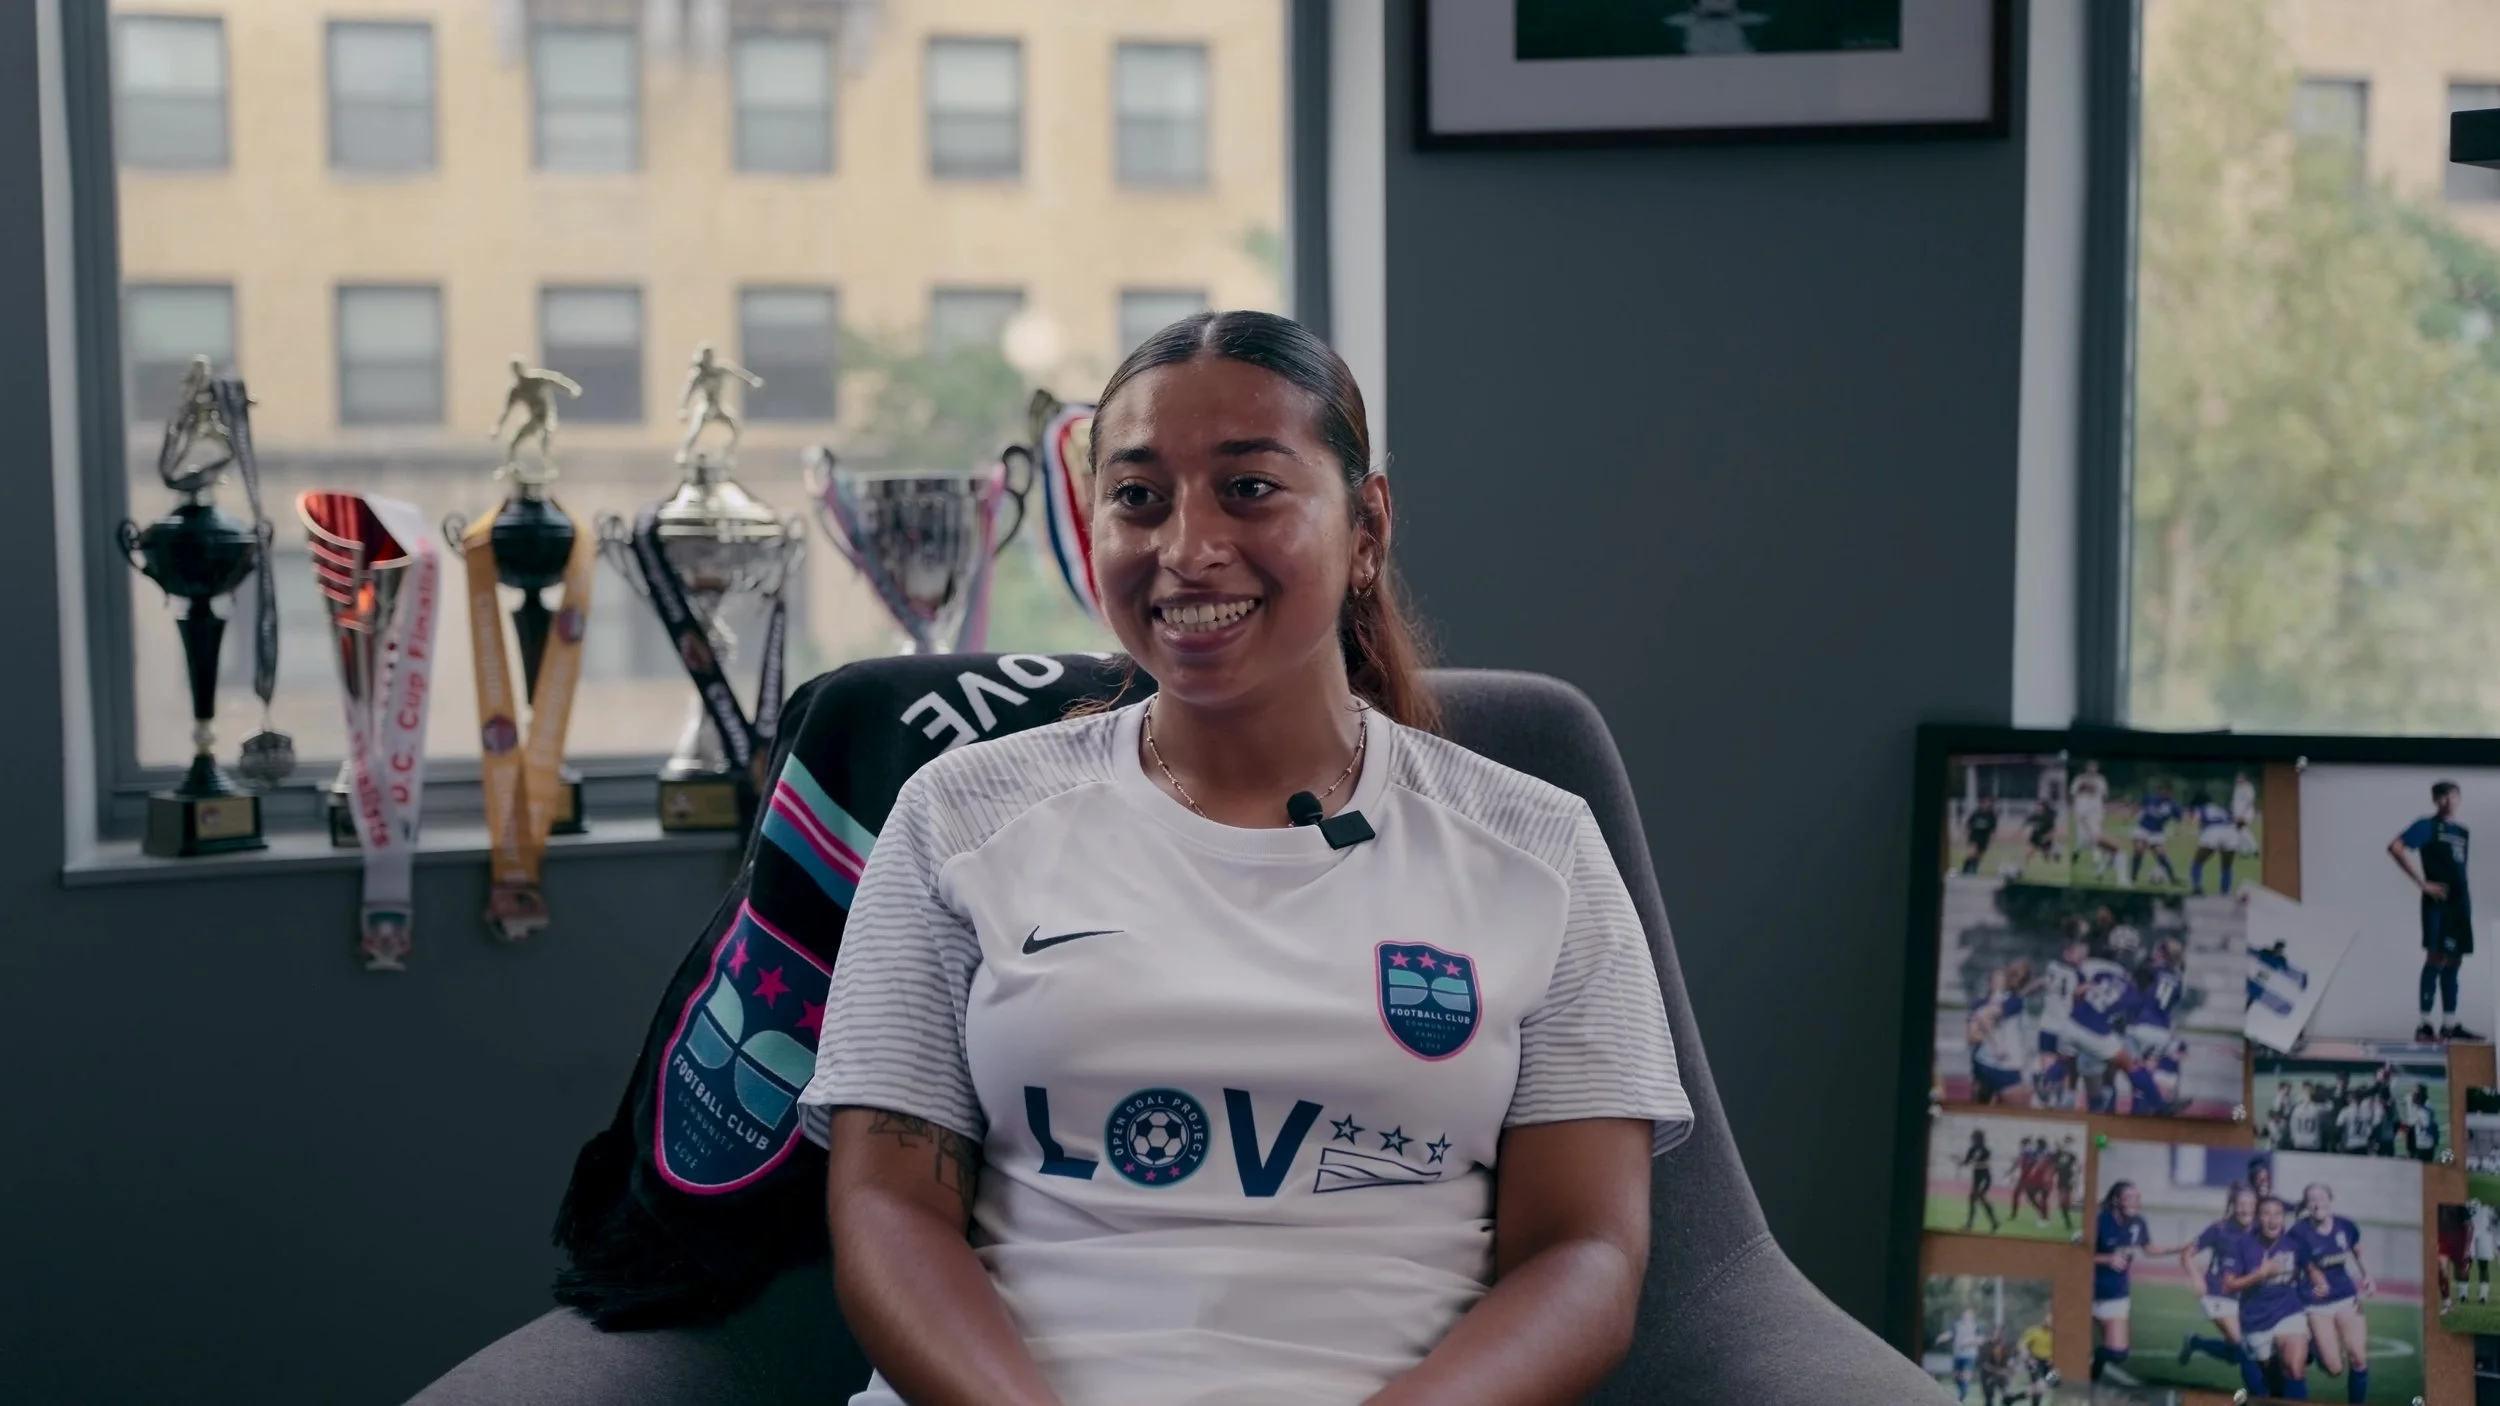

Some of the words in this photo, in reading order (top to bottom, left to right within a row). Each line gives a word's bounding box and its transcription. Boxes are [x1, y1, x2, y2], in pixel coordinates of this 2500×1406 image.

[397, 672, 428, 730] Cup
[900, 652, 1113, 760] OVE
[1390, 1007, 1443, 1020] FOOTBALL
[1445, 1013, 1471, 1025] CLUB
[672, 1053, 724, 1119] FOOTBALL
[726, 1112, 770, 1151] CLUB
[677, 1092, 736, 1152] COMMUNITY
[1112, 1117, 1127, 1156] OPEN
[1126, 1095, 1165, 1114] GOAL
[1171, 1098, 1204, 1163] PROJECT
[673, 1141, 698, 1170] LOVE
[681, 1119, 712, 1157] FAMILY
